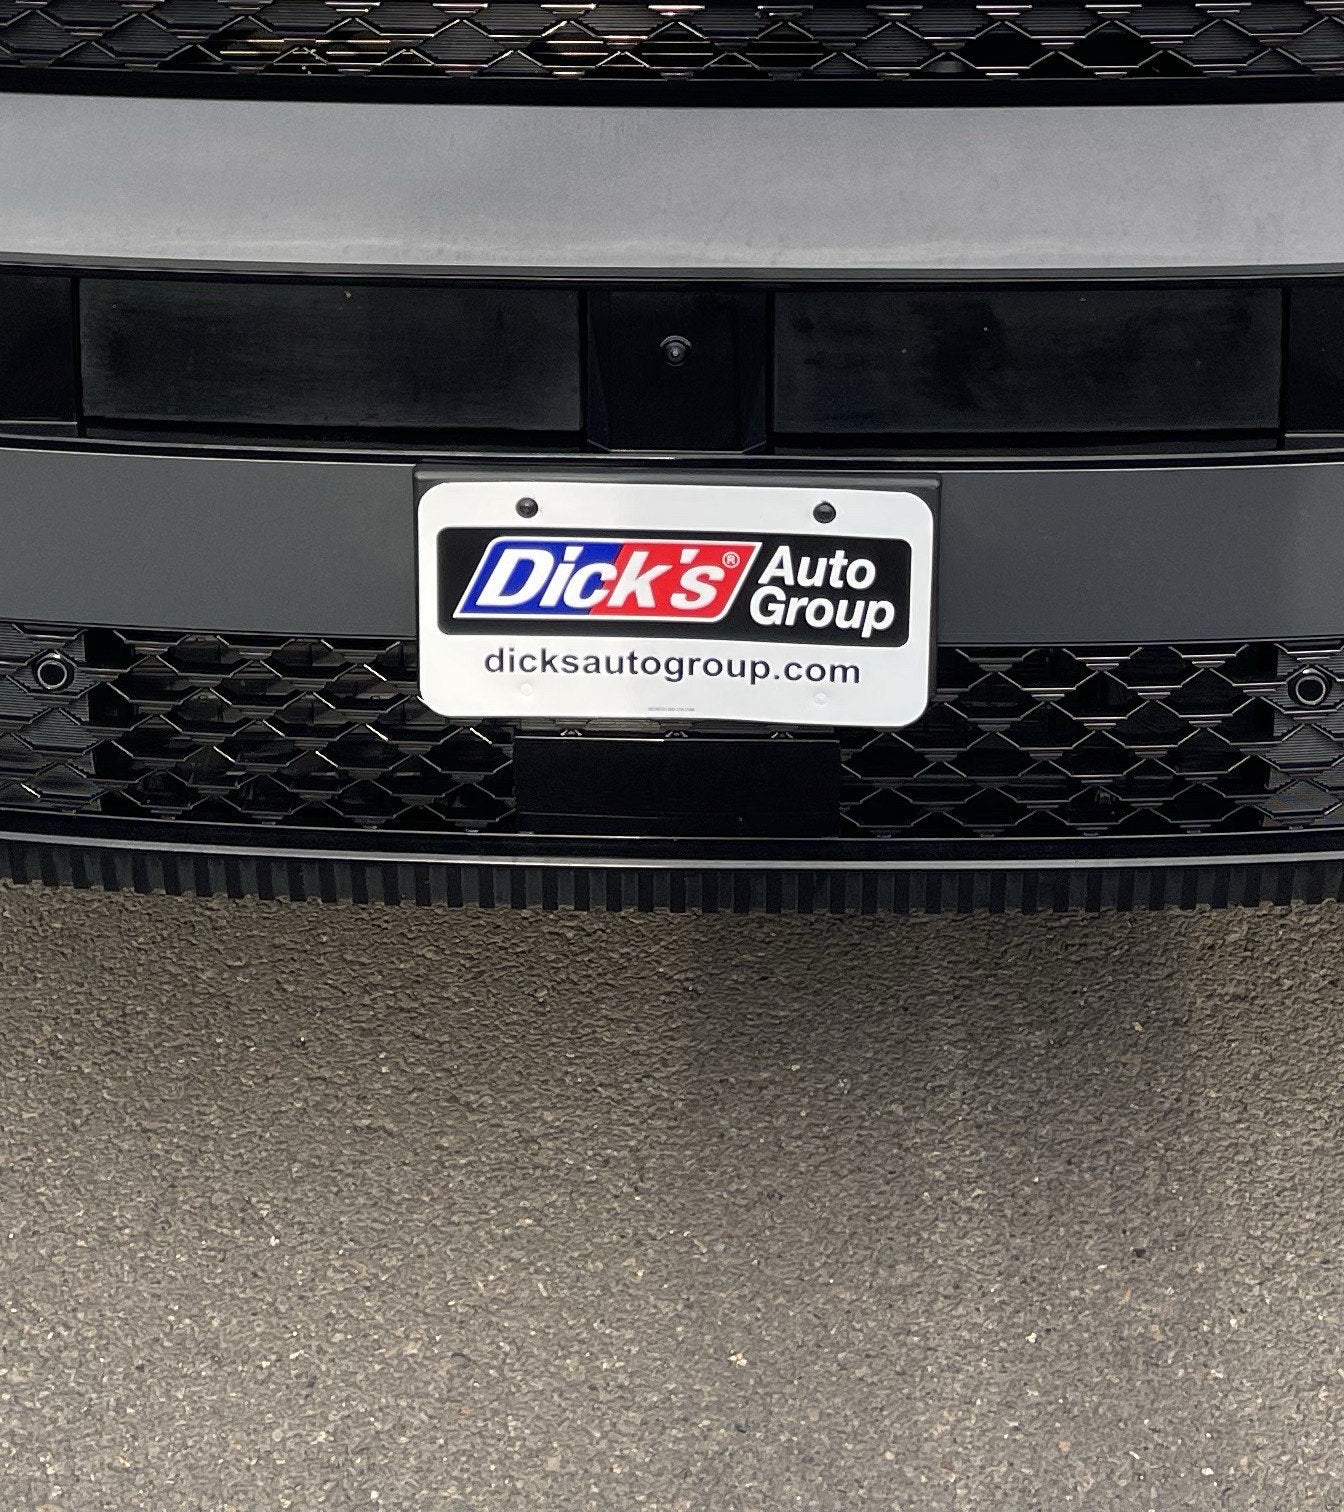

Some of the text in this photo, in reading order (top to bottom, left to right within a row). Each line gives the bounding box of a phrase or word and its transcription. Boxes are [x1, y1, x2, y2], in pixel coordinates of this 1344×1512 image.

[758, 545, 876, 589] Auto
[750, 586, 895, 638] Group
[484, 647, 860, 684] dicksautogroup.com
